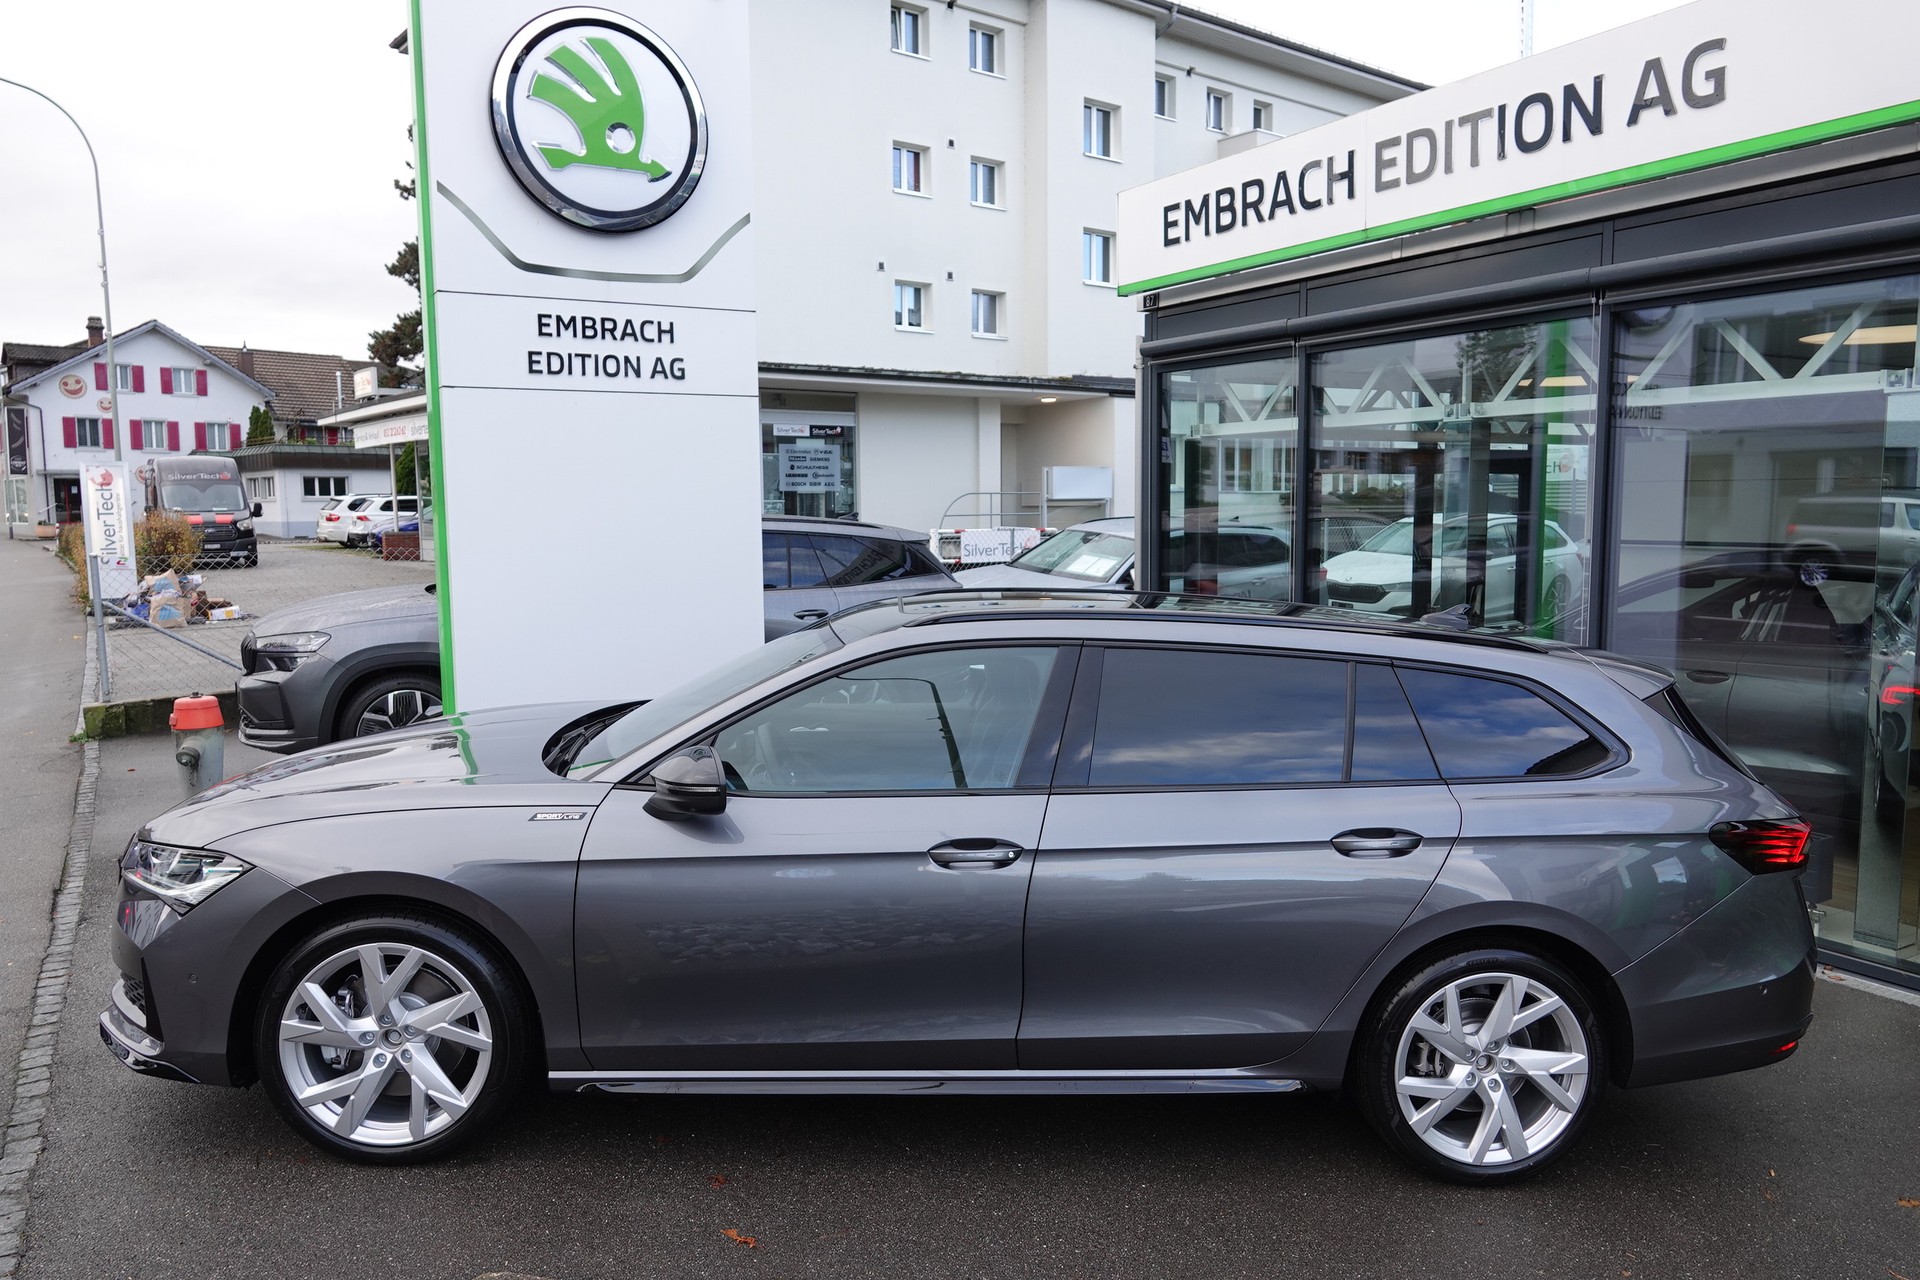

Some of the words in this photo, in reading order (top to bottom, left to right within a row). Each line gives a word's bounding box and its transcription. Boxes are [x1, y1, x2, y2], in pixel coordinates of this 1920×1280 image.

[1162, 149, 1356, 248] EMBRACH
[1374, 73, 1605, 193] EDITION
[1626, 37, 1727, 128] AG
[1145, 295, 1155, 307] 87
[537, 313, 675, 344] EMBRACH
[527, 350, 642, 378] EDITION
[650, 356, 686, 380] AG
